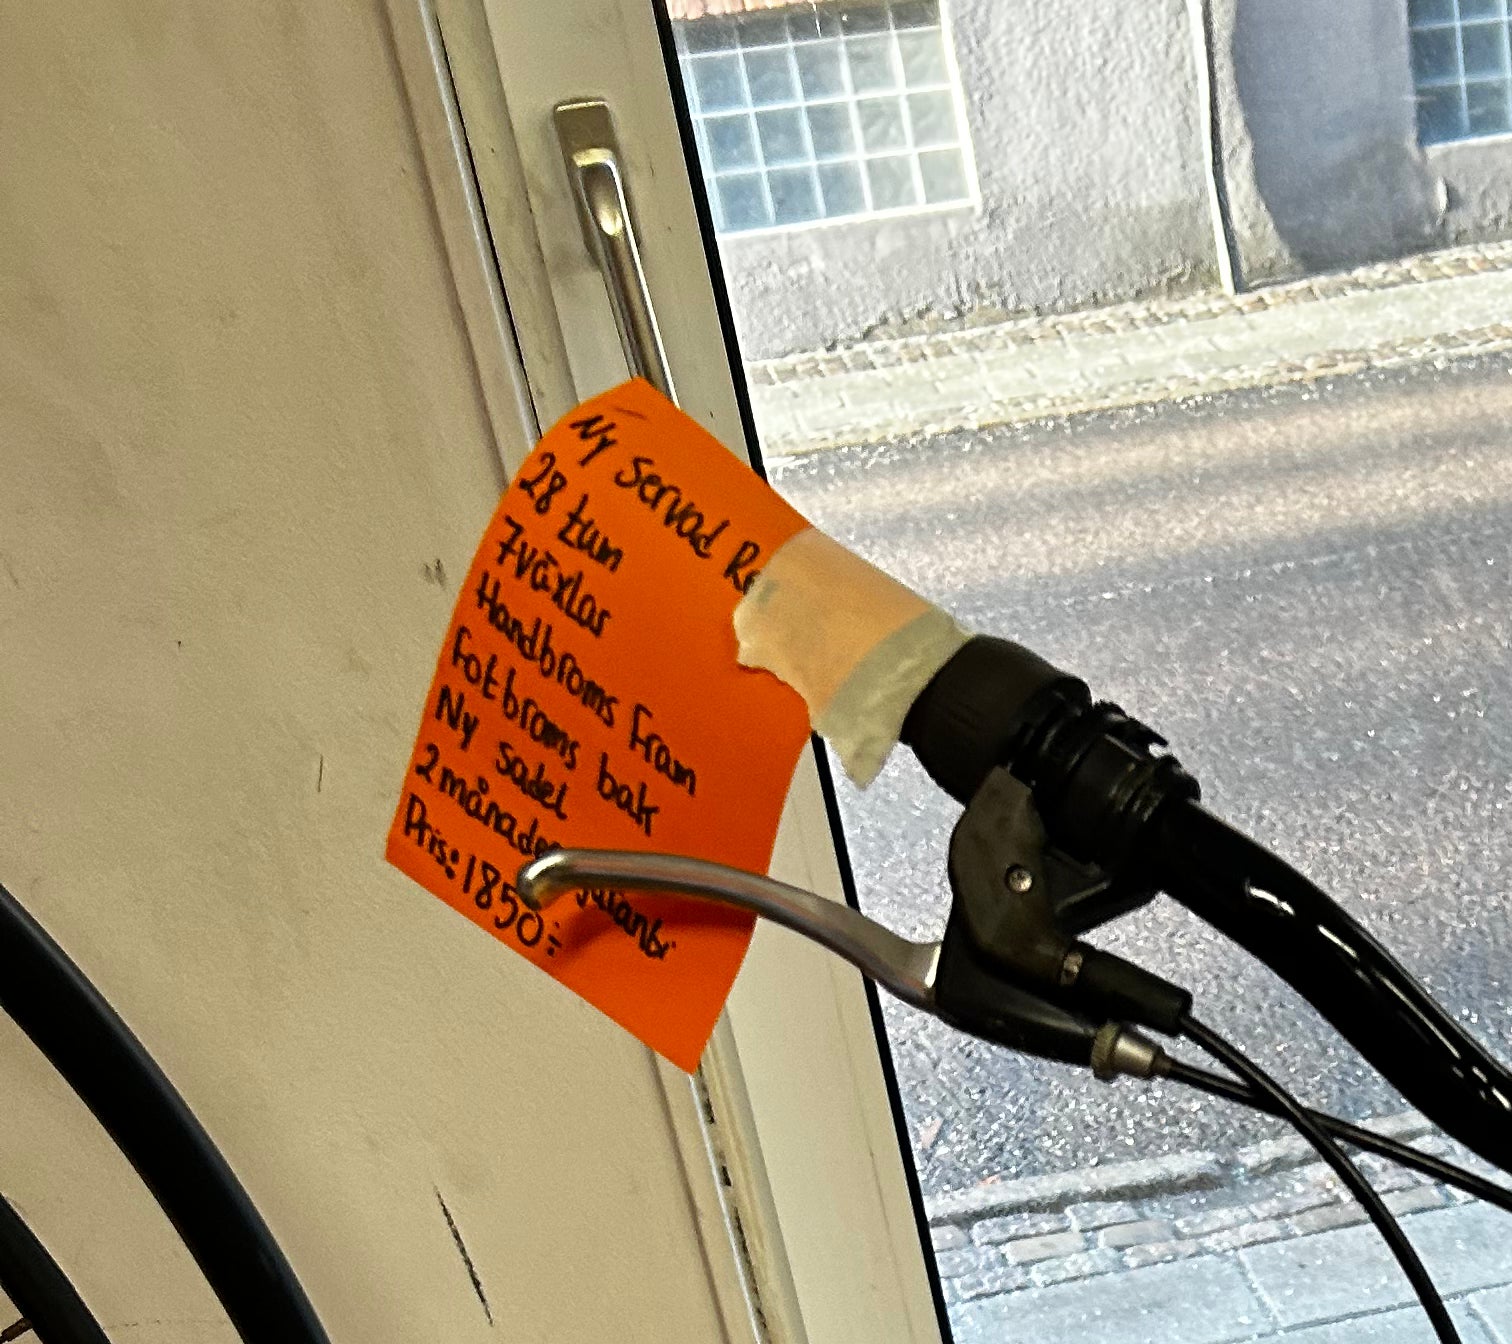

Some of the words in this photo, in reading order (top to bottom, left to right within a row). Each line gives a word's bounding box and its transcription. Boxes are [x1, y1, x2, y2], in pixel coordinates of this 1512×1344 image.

[569, 414, 618, 467] Ny
[519, 451, 567, 515] 28
[557, 493, 623, 573] tum
[477, 570, 619, 728] Handbroms
[435, 685, 479, 751] Ny
[597, 751, 659, 837] bak
